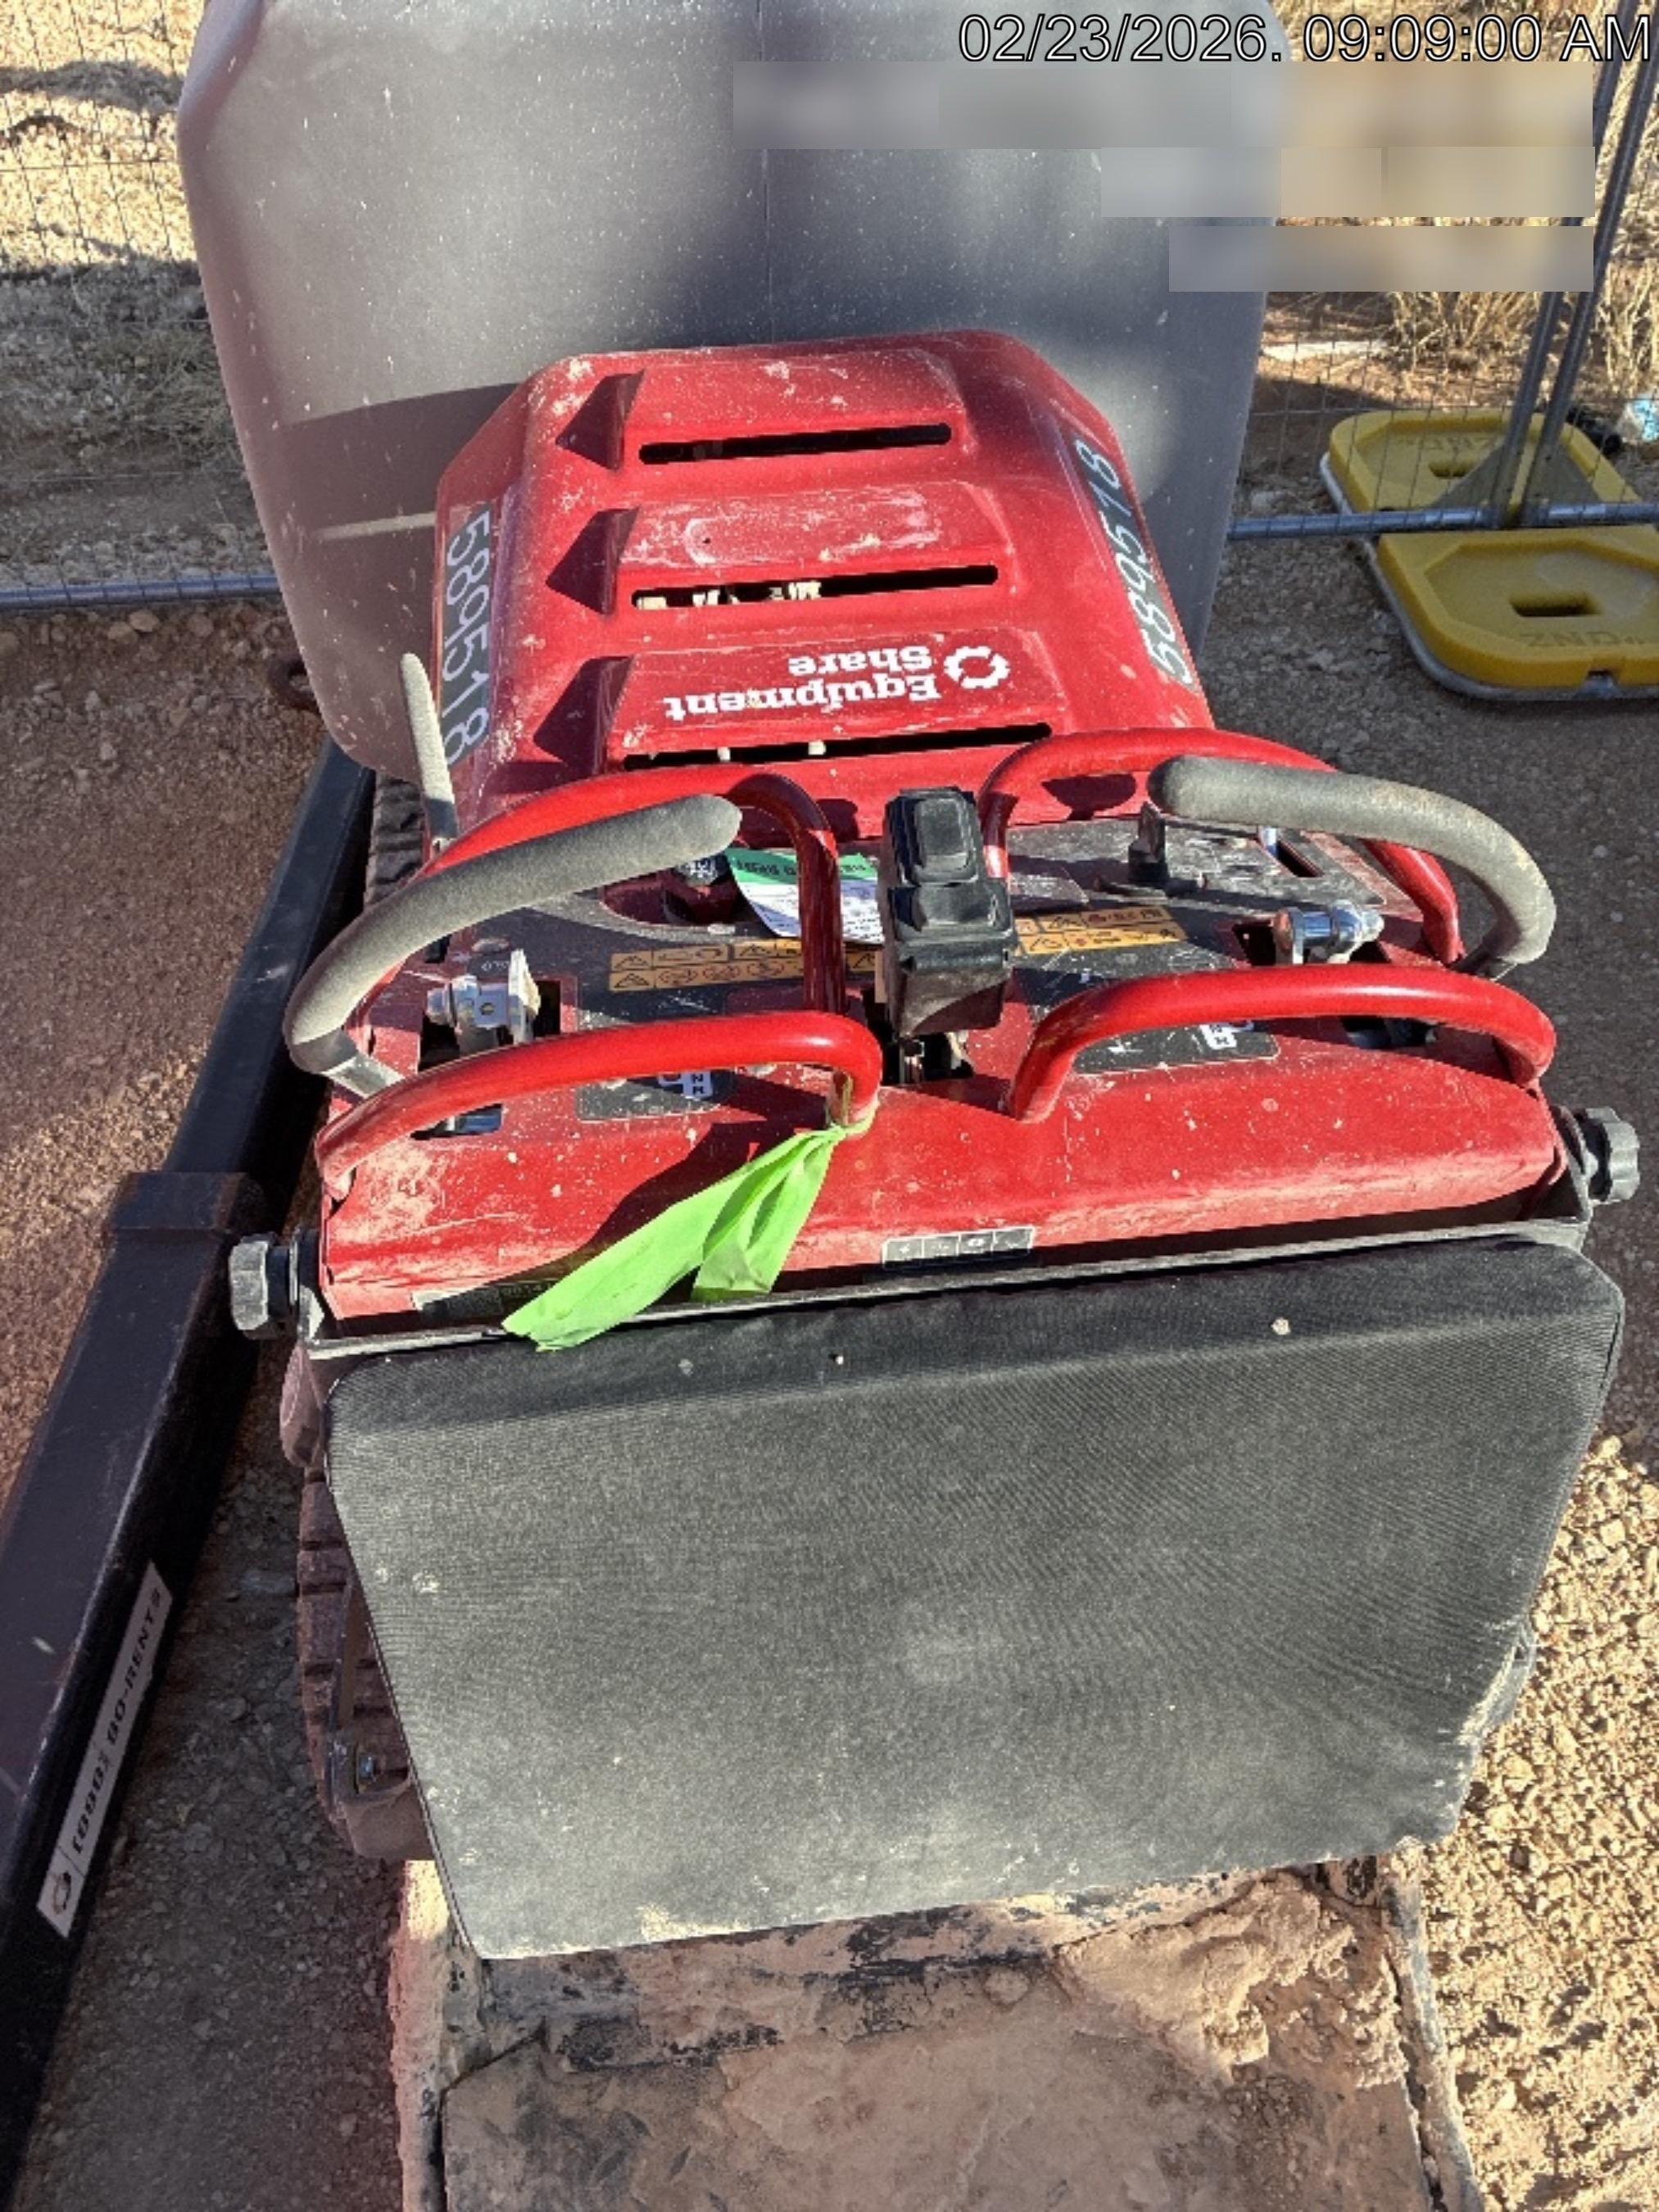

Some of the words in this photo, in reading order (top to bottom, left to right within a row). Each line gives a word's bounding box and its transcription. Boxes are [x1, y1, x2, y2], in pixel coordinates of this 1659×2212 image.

[1075, 439, 1191, 684] 589518
[442, 510, 491, 765] 589518
[662, 672, 941, 721] Equipment
[787, 645, 934, 677] Share
